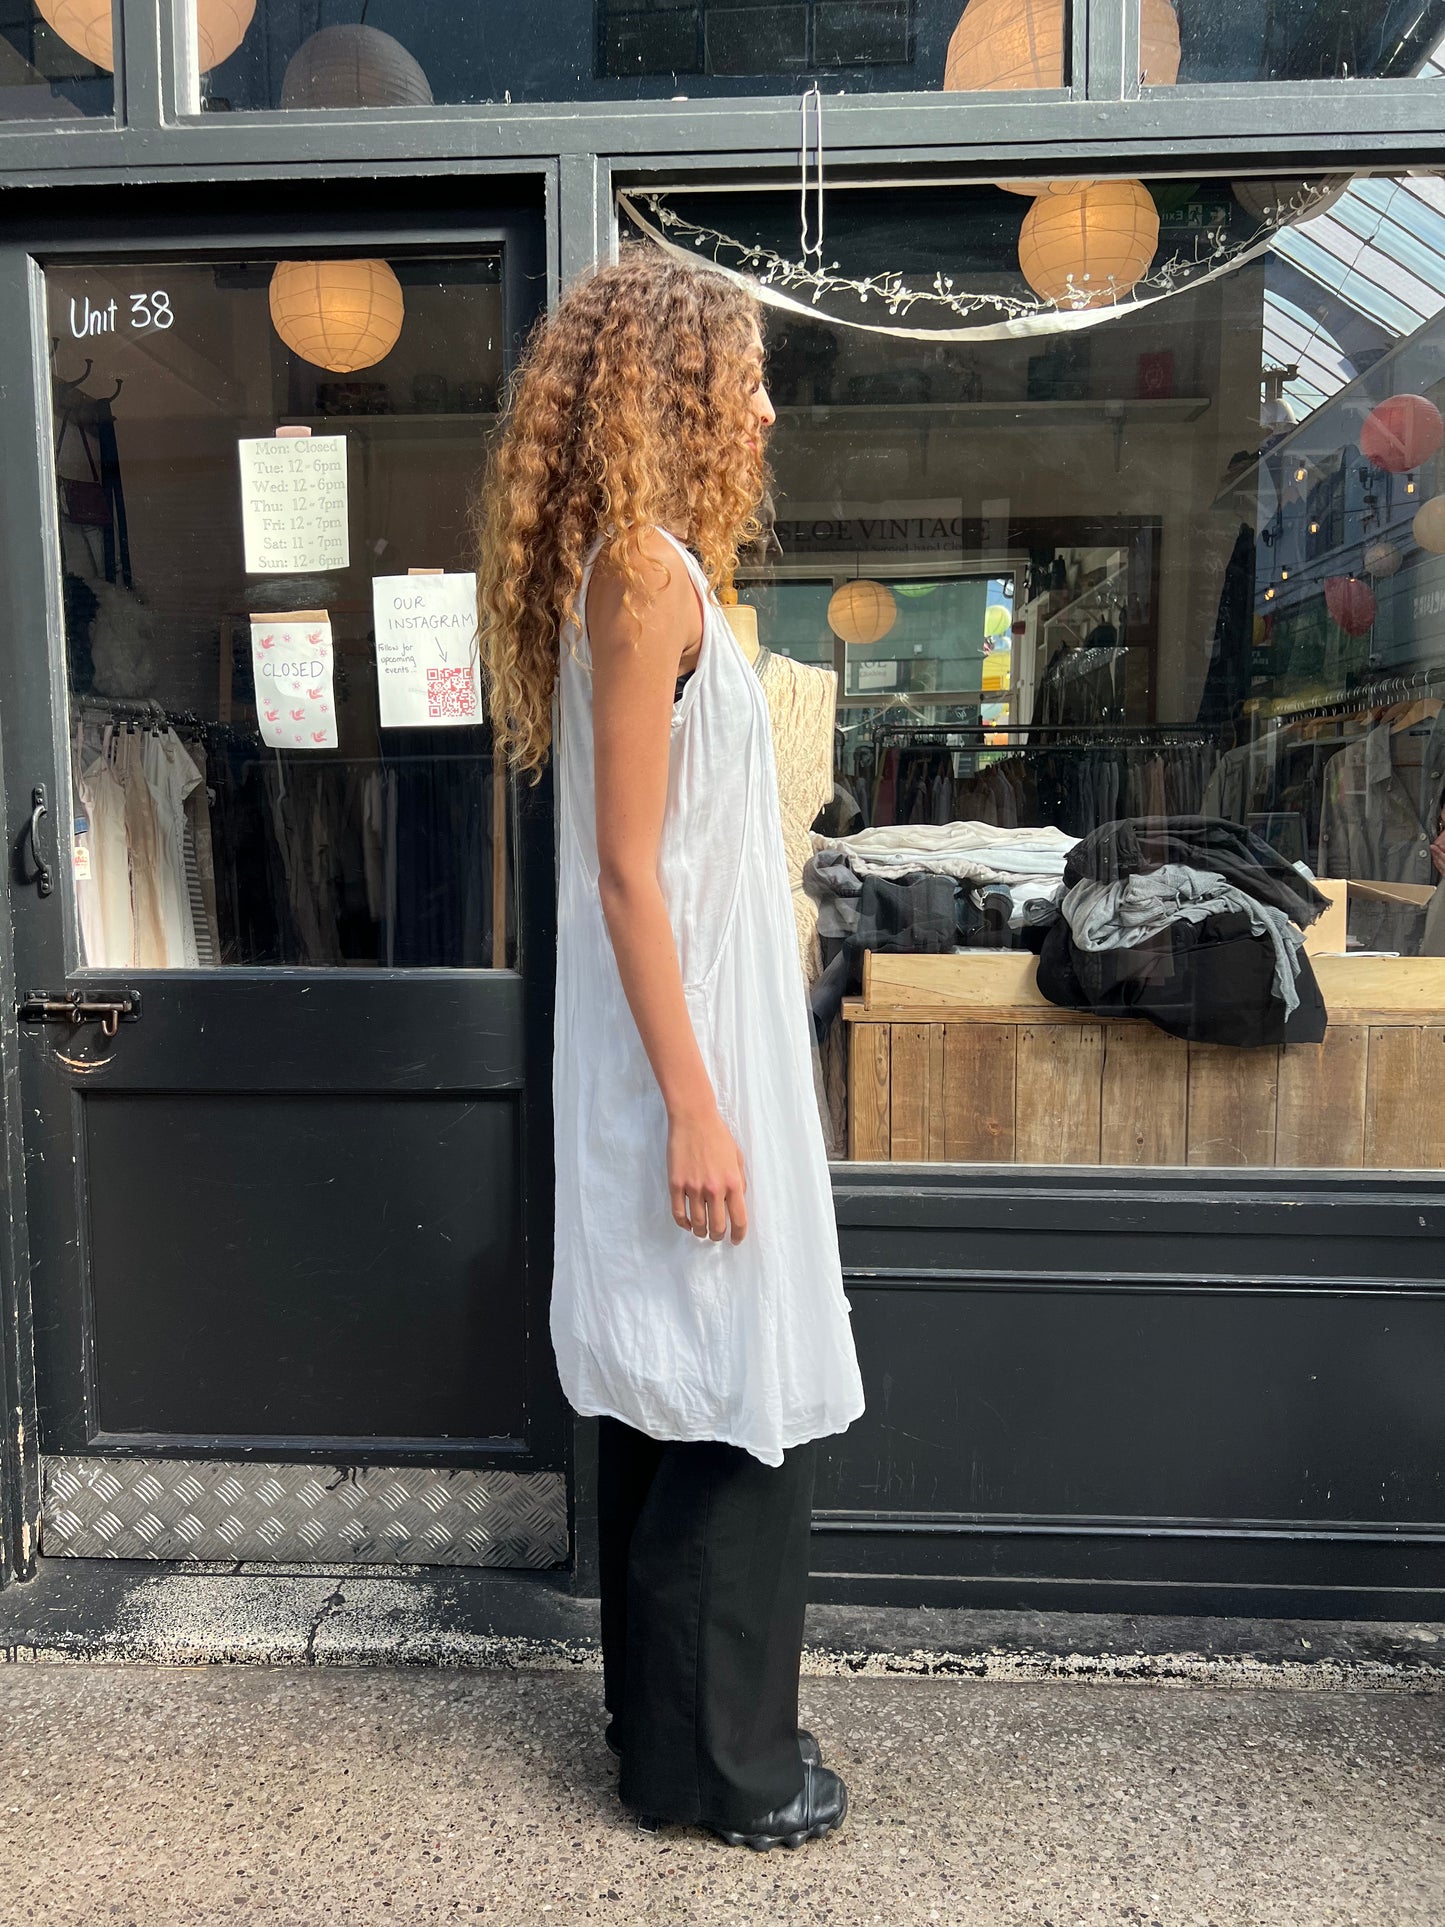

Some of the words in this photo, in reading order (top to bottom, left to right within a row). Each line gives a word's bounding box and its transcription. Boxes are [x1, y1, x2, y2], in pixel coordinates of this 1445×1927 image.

[71, 296, 118, 339] Unit
[129, 290, 174, 329] 38
[255, 442, 290, 455] Mon:
[294, 439, 338, 454] Closed
[253, 461, 284, 474] Tue:
[313, 459, 341, 475] 6pm
[252, 480, 289, 493] Wed:
[317, 478, 346, 494] 6pm
[250, 500, 283, 513] Thu:
[317, 497, 345, 513] 7pm
[262, 518, 285, 531] Fri:
[315, 516, 342, 532] 7pm
[263, 537, 287, 550] Sat:
[317, 536, 342, 551] 7pm
[258, 556, 288, 568] Sun:
[318, 554, 345, 570] 6pm
[393, 596, 426, 610] OUR
[388, 613, 474, 630] INSTAGRAM
[378, 643, 399, 653] Follow
[402, 643, 413, 656] for
[262, 660, 324, 678] CLOSED
[380, 655, 417, 668] upcoming
